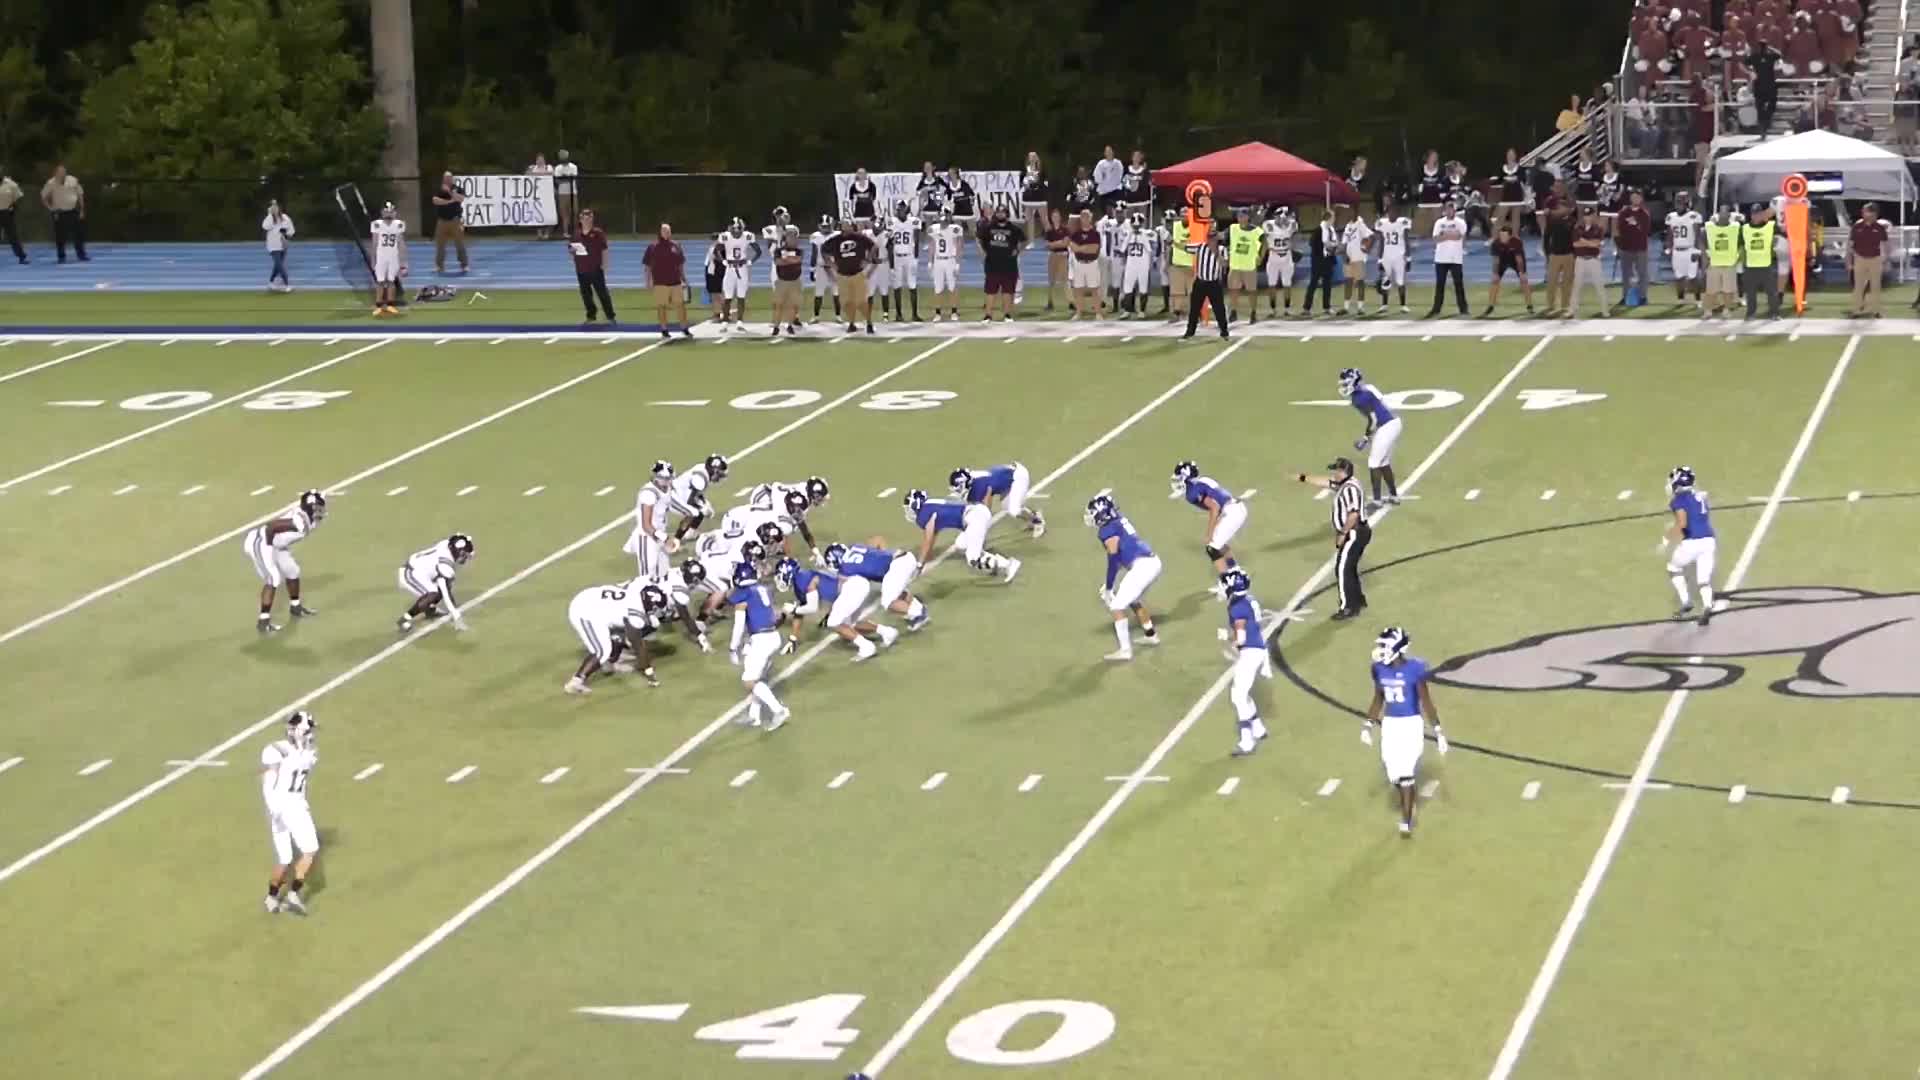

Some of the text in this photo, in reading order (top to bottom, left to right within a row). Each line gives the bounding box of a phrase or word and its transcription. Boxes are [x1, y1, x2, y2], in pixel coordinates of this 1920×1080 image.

[499, 178, 541, 200] TIDE
[986, 173, 1016, 191] PLA
[465, 200, 544, 225] EAT DOGS
[382, 233, 396, 247] 39
[895, 231, 910, 244] 26
[939, 239, 947, 253] 9
